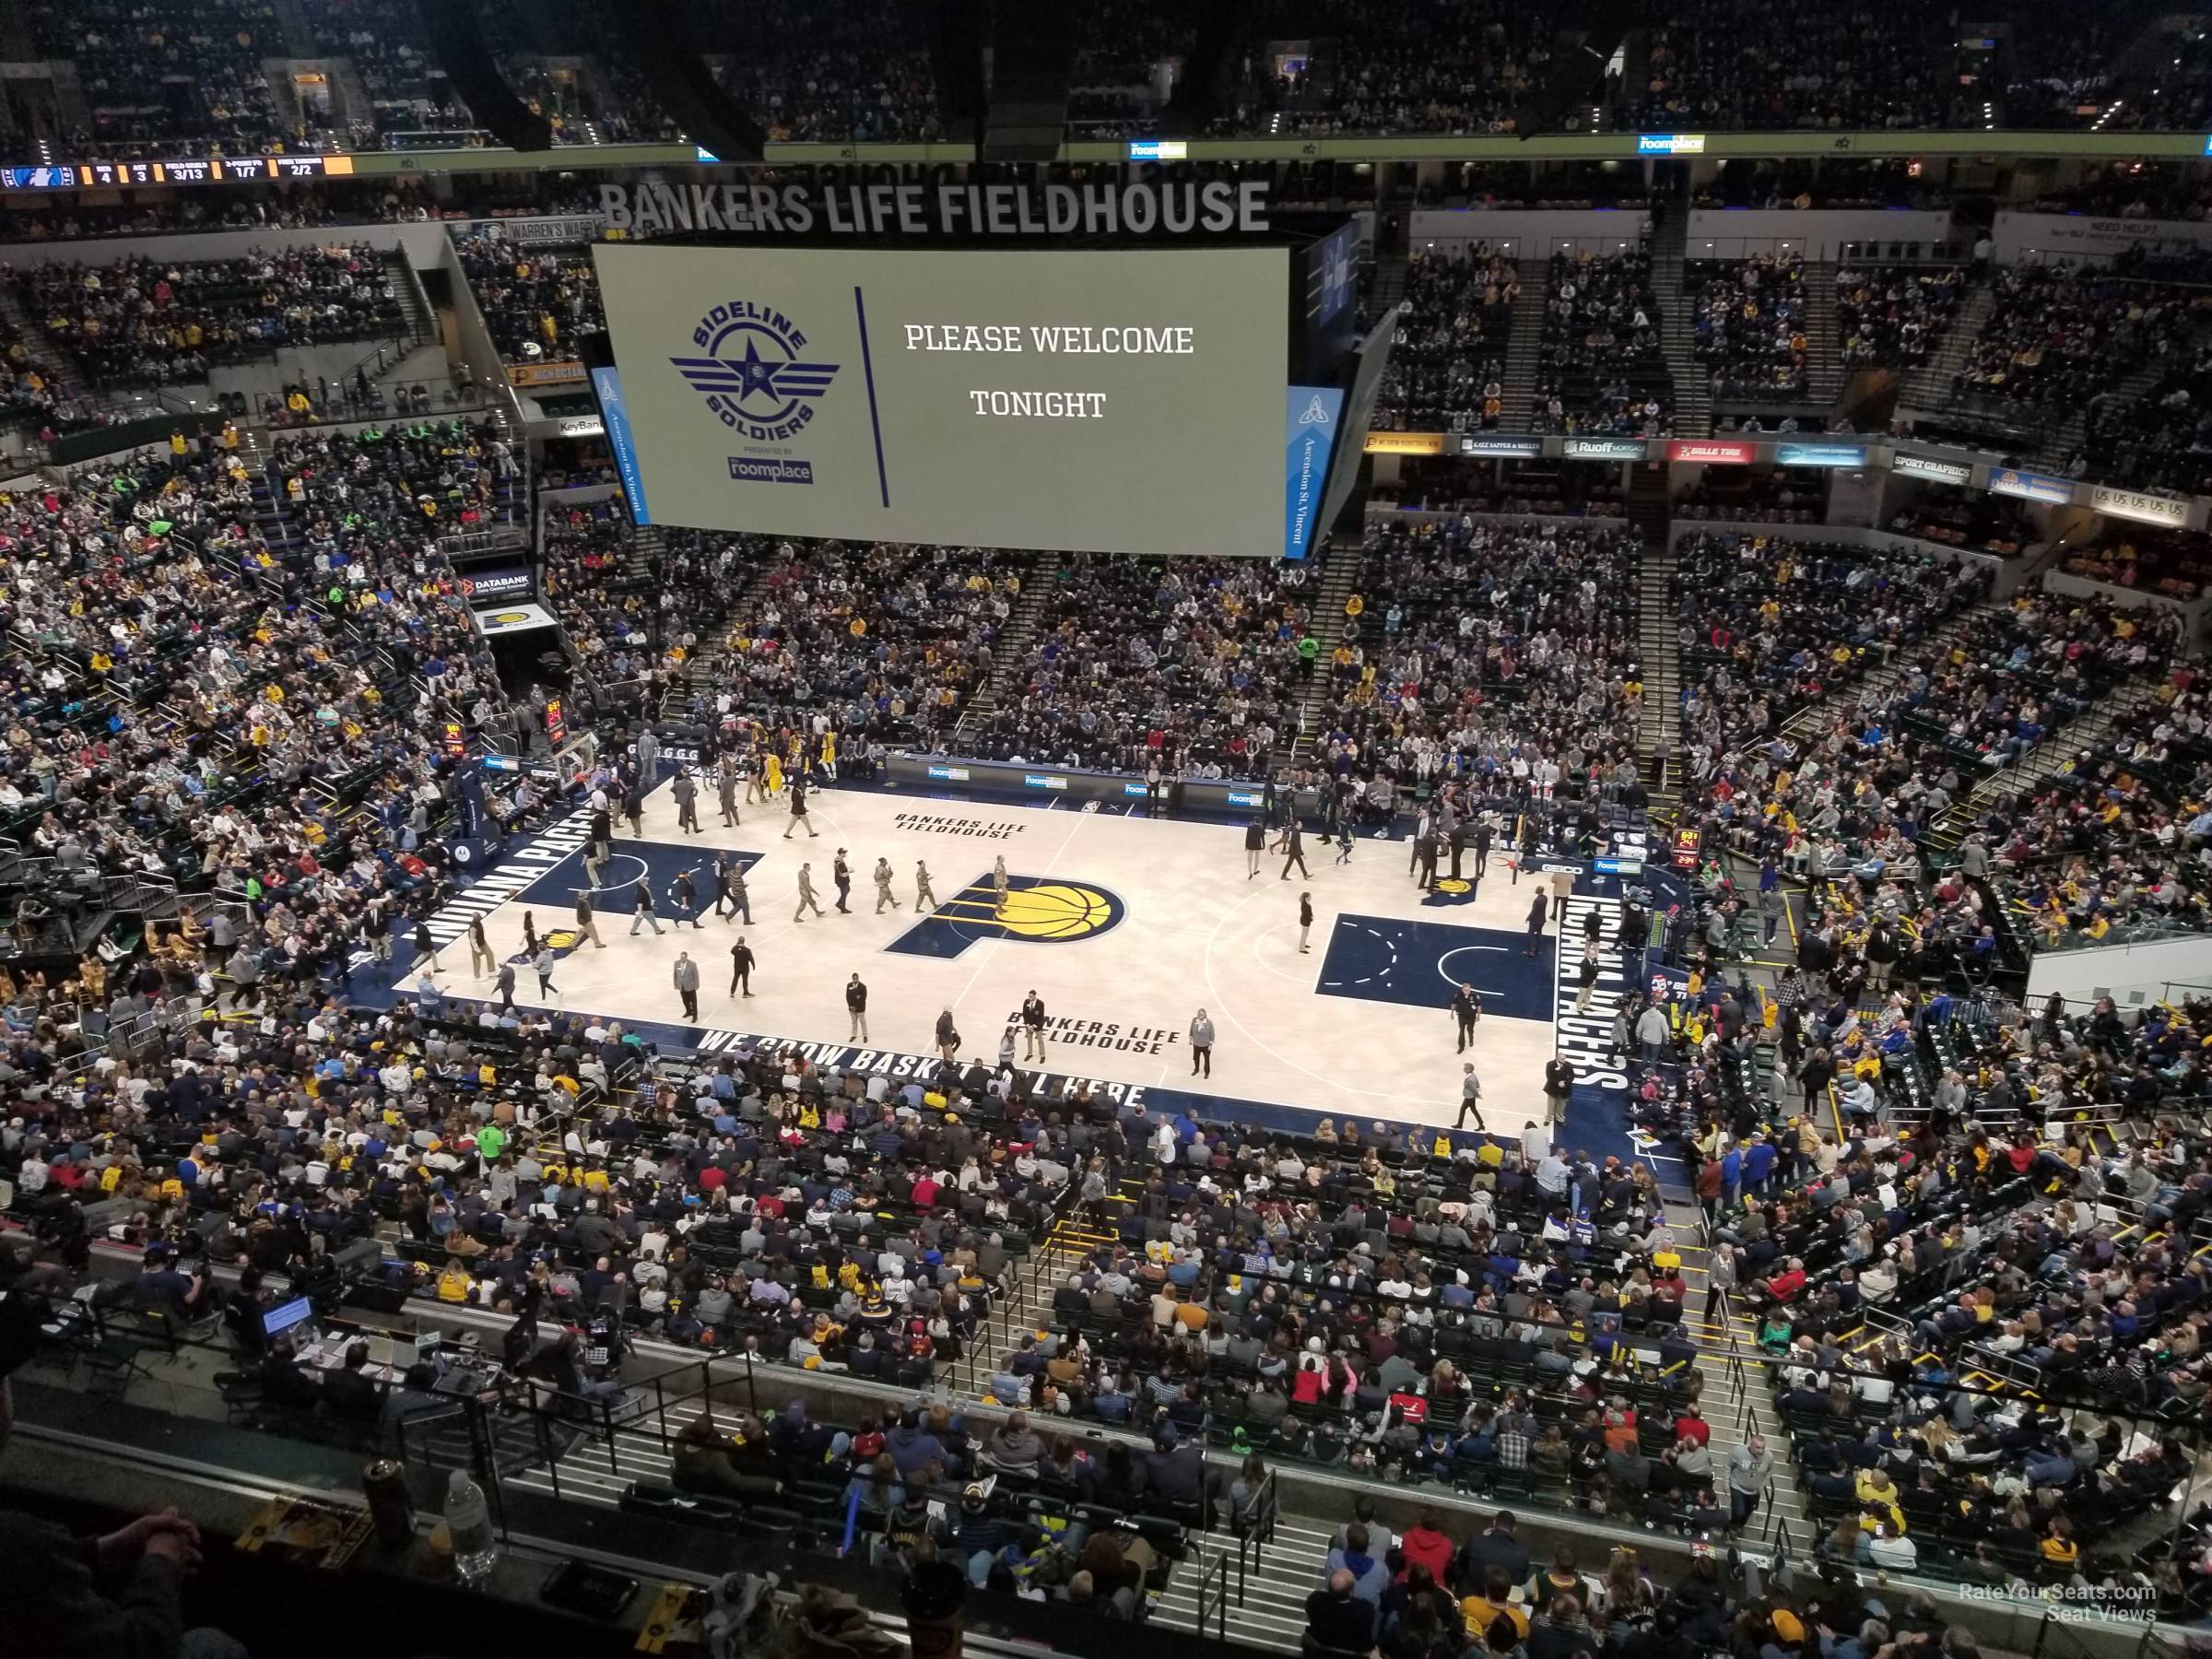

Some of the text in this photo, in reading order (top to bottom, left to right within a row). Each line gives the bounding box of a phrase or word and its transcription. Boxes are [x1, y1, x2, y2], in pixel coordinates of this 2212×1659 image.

[101, 172, 111, 182] 4
[137, 171, 147, 182] 3
[173, 169, 203, 180] 3/13
[236, 167, 255, 177] 1/7
[291, 165, 312, 175] 2/2
[599, 182, 1270, 234] BANKERS LIFE FIELDHOUSE
[693, 300, 807, 350] SIDELINE
[904, 324, 1194, 354] PLEASE WELCOME
[970, 391, 1106, 418] TONIGHT
[560, 420, 603, 433] KeyBan
[705, 394, 814, 441] SOLDIERS
[1579, 441, 1613, 452] Ruoff
[732, 459, 811, 482] roomplace
[1300, 438, 1316, 490] Ascension
[1895, 456, 1971, 477] SPORT GRAPHICS
[1292, 505, 1309, 546] Vincent
[476, 575, 529, 589] DATABANK
[628, 744, 637, 754] G
[677, 748, 686, 758] G
[689, 749, 699, 760] G
[895, 813, 1028, 833] BANKERS LIFE
[896, 821, 1013, 840] FIELDHOUSE
[1564, 827, 1576, 838] G
[1680, 839, 1693, 847] 24
[1542, 864, 1583, 876] GEICO
[1007, 1012, 1181, 1043] BNKERS LIFE
[697, 1030, 749, 1053] WE
